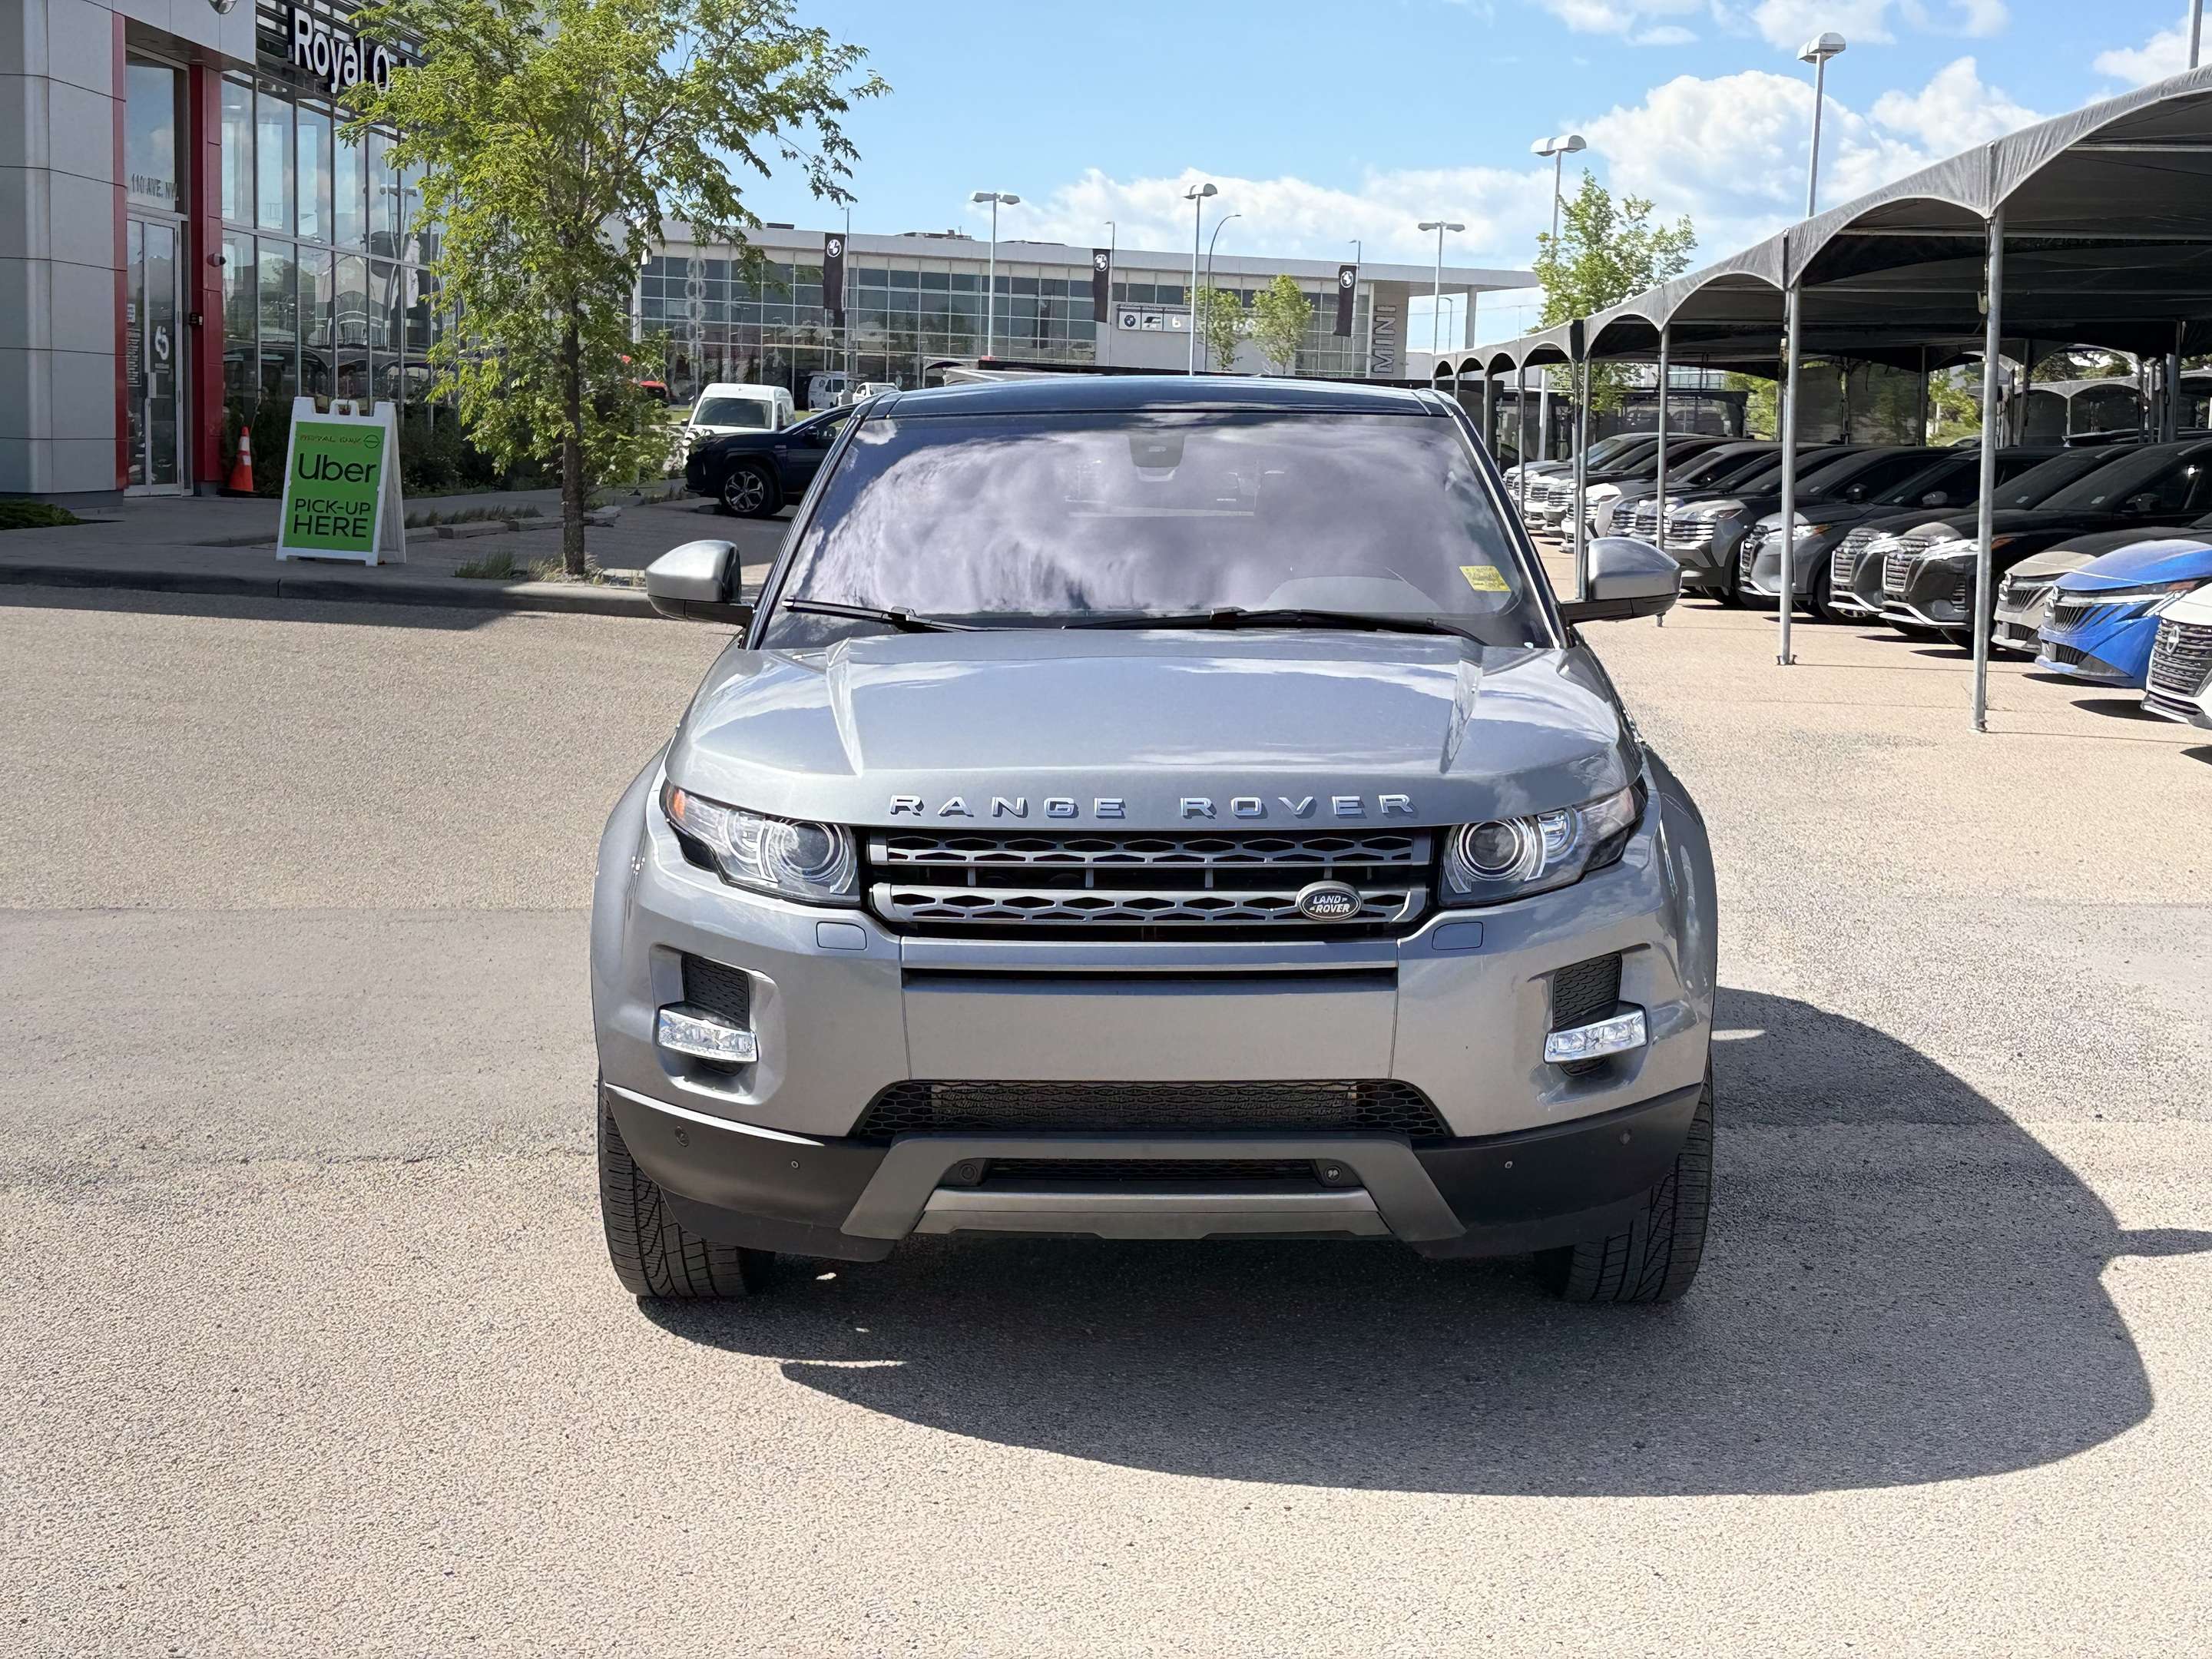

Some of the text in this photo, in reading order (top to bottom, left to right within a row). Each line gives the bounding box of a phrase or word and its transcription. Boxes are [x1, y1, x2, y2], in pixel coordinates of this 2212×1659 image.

[293, 7, 366, 94] Royal
[1372, 305, 1396, 373] MINI
[298, 452, 377, 483] Uber
[294, 498, 371, 515] PICK-UP
[293, 514, 369, 538] HERE
[889, 793, 1416, 819] RANGE ROVER
[1313, 895, 1342, 905] LAND
[1315, 903, 1351, 913] ROVER
